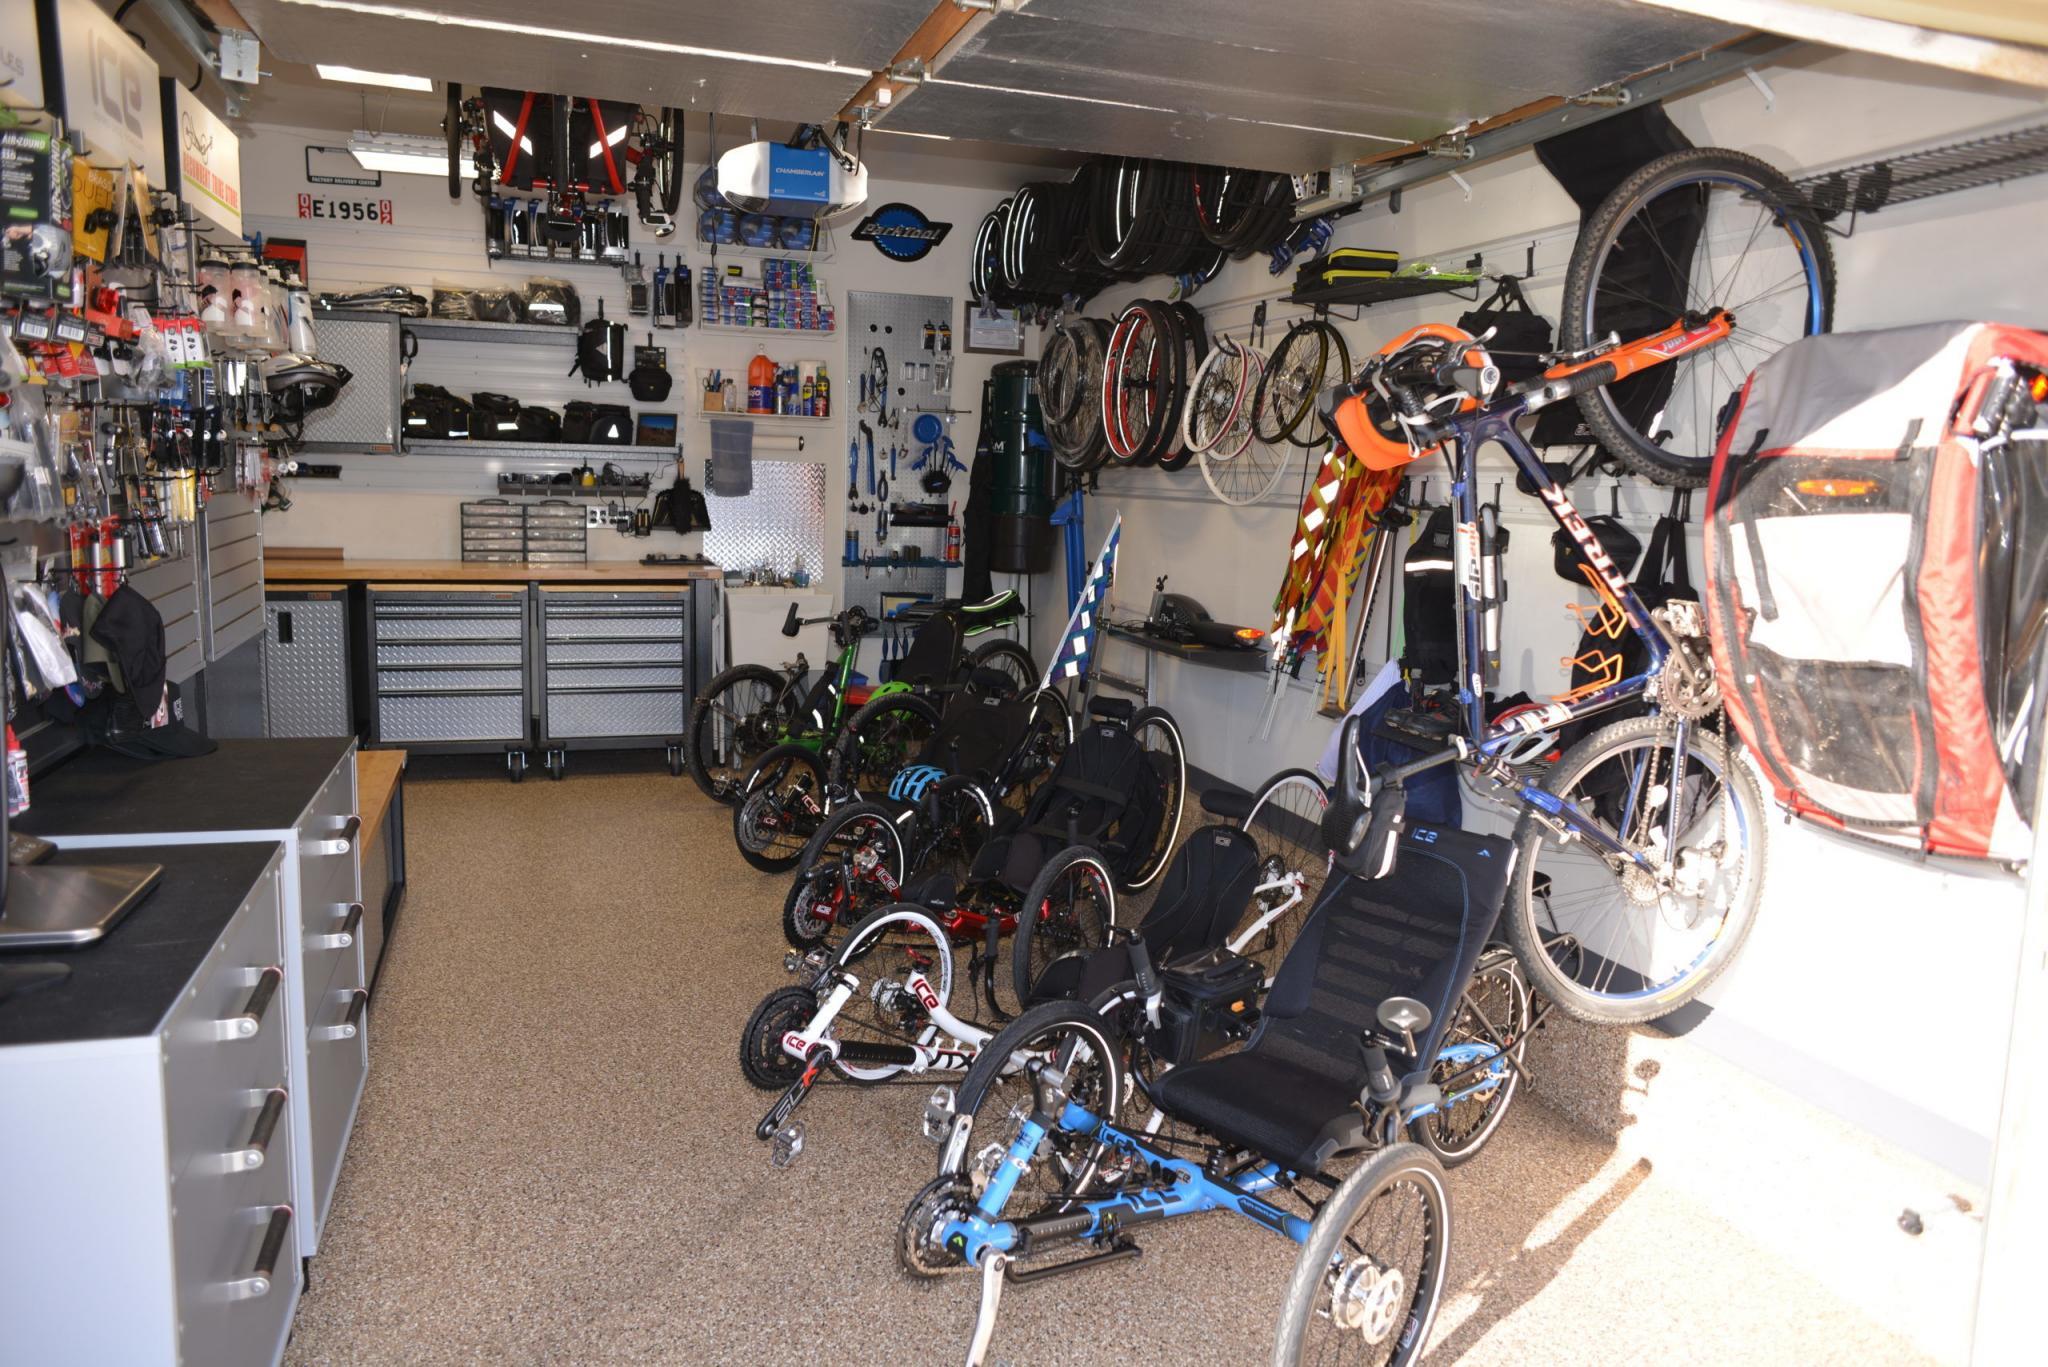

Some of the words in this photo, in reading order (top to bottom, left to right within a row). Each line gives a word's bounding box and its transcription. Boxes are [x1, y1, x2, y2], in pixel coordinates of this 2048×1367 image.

[775, 167, 824, 177] CHAMBERLAIN
[312, 199, 379, 221] E1956
[1541, 482, 1630, 598] TREK
